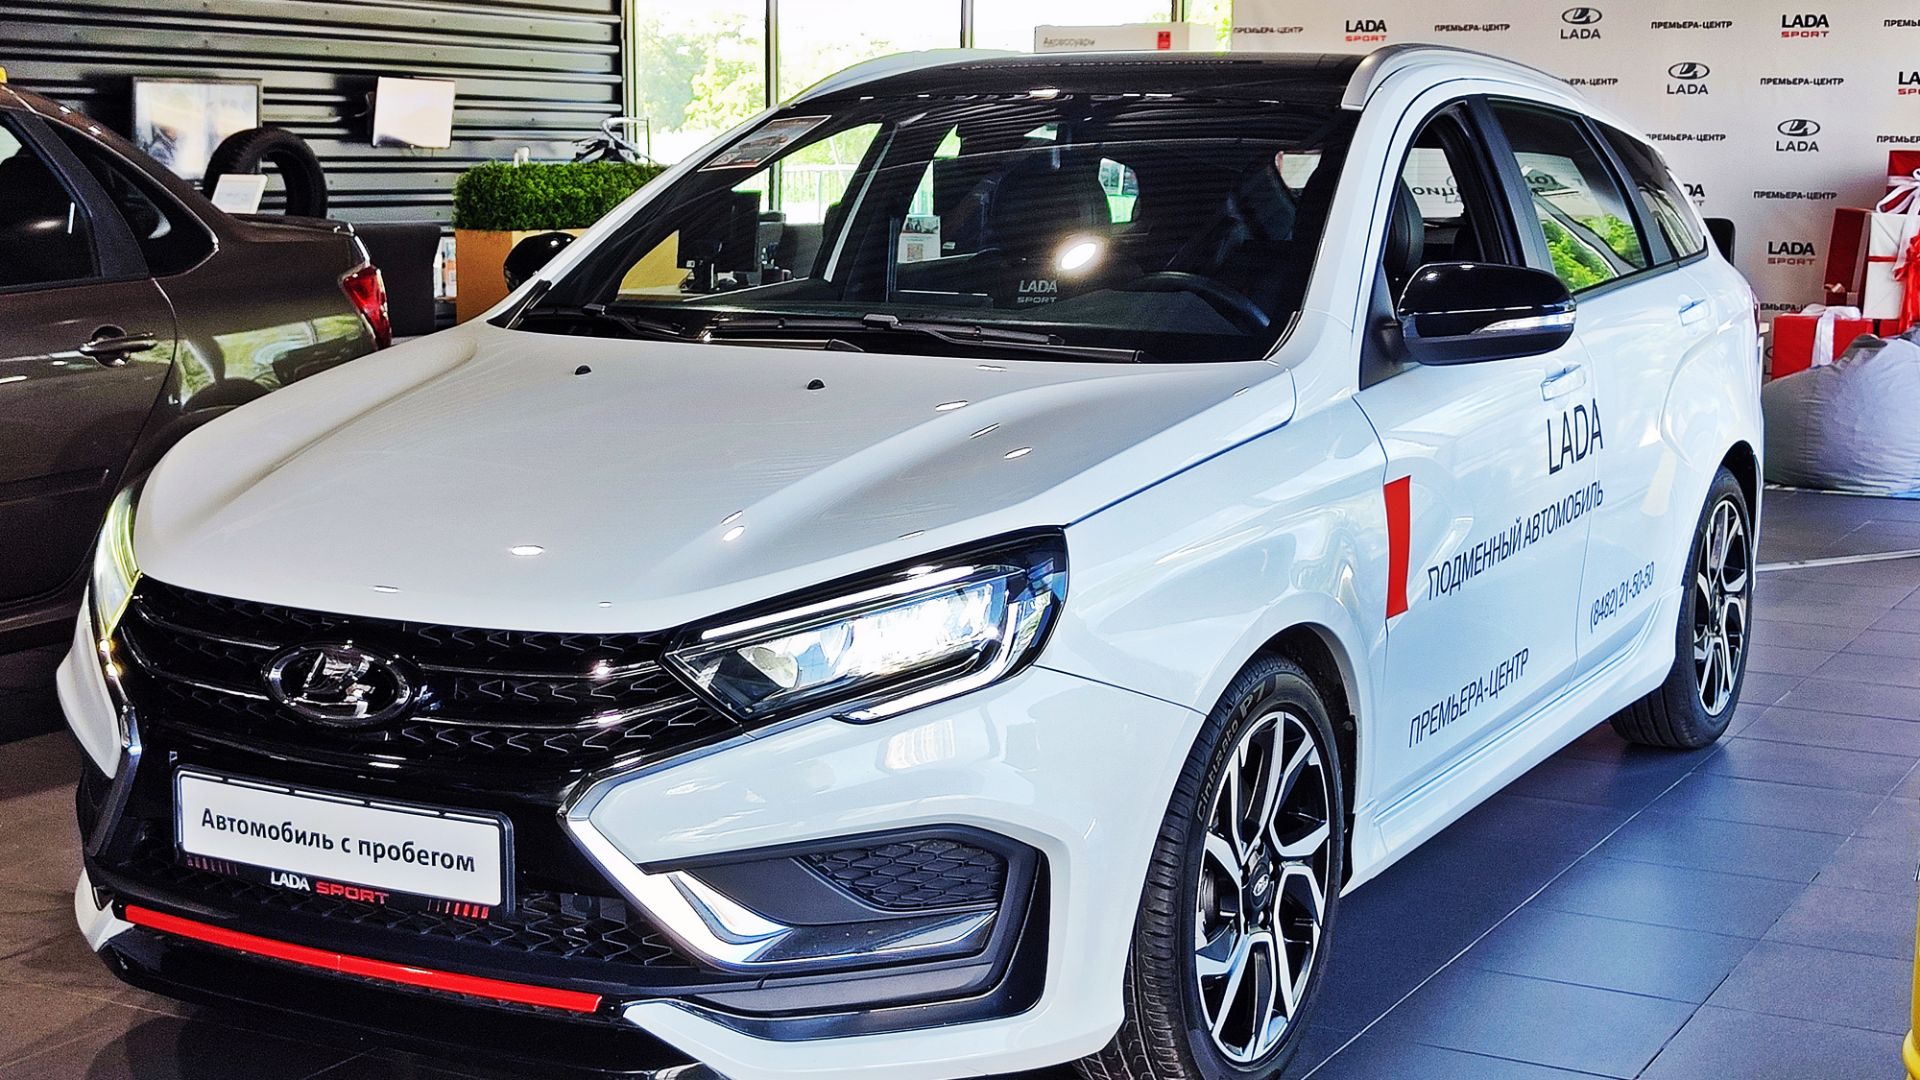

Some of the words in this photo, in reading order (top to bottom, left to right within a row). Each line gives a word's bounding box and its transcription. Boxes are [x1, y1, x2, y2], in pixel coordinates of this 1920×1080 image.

[1345, 19, 1387, 33] LADA
[1650, 21, 1733, 30] ПРЕМЬЕРА-ЦЕНТР
[1782, 14, 1830, 28] LADA
[1434, 23, 1511, 33] ПРЕМЬЕРА-ЦЕНТР
[1560, 29, 1602, 40] LADA
[1760, 77, 1844, 86] ПРЕМЬЕРА-ЦЕНТР
[1666, 84, 1709, 95] LADA
[1646, 133, 1726, 142] ПРЕМЬЕРА-ЦЕНТР
[1776, 141, 1819, 152] LADA
[1753, 191, 1837, 200] ПРЕМЬЕРА-ЦЕНТР
[1768, 241, 1815, 256] LADA
[1019, 280, 1058, 293] LADA
[1017, 296, 1057, 304] SPORT
[1547, 398, 1604, 475] LADA
[1427, 516, 1523, 601] ПОДМЕННЫЙ
[1523, 480, 1604, 550] АВТОМОБИЛЬ
[1589, 590, 1620, 634] (8482)
[1618, 561, 1655, 612] 21-50-50
[1239, 680, 1267, 718] P7
[1409, 647, 1530, 748] ПРЕМЬЕРА-ЦЕНТР
[201, 807, 334, 850] Автомобиль
[341, 836, 351, 854] с
[358, 838, 475, 873] пробегом
[271, 871, 309, 892] LADA
[316, 881, 389, 902] SPORT
